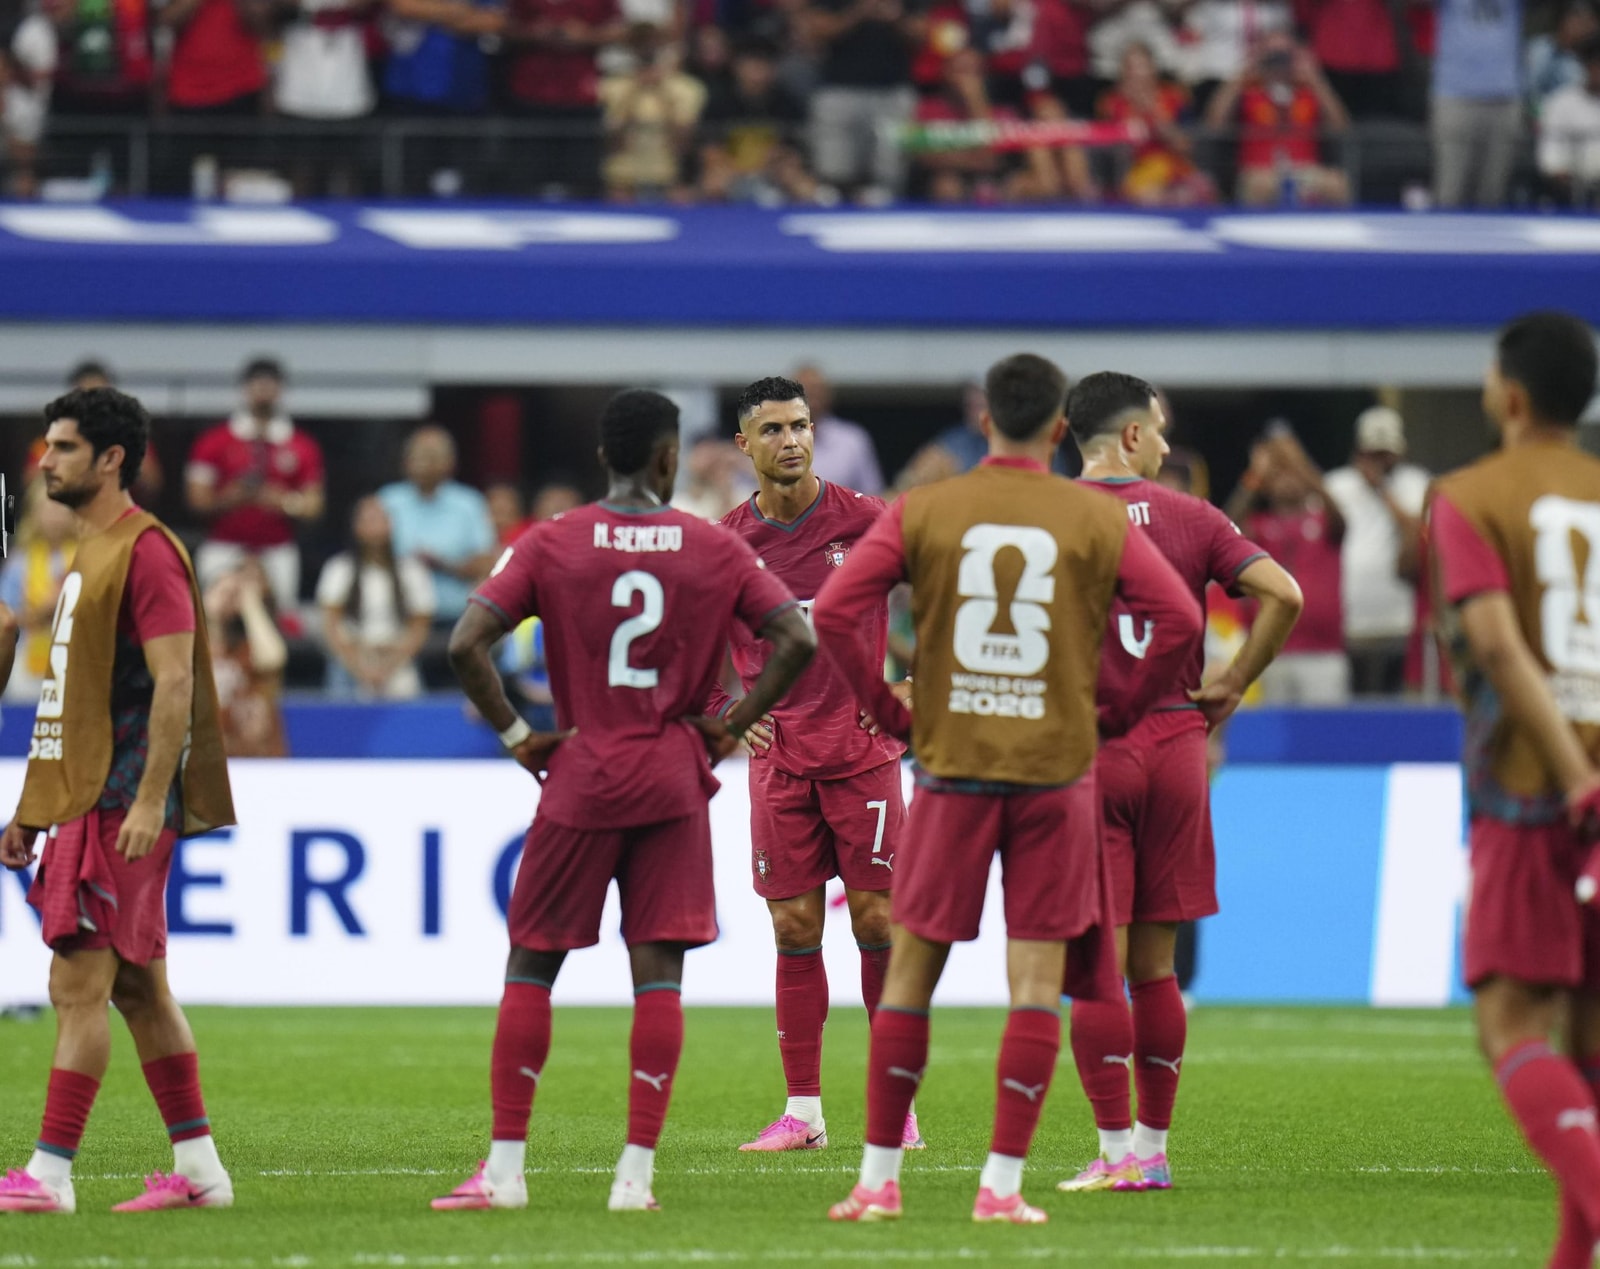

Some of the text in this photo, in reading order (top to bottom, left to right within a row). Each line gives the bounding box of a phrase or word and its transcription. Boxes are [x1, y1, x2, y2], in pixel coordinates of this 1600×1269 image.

[613, 525, 682, 552] SEMEDO
[608, 570, 664, 688] 2
[982, 642, 1022, 660] FIFA
[42, 687, 58, 702] FA
[951, 671, 1048, 696] WORLD CUP
[948, 688, 1046, 720] 2026
[866, 799, 887, 853] 7
